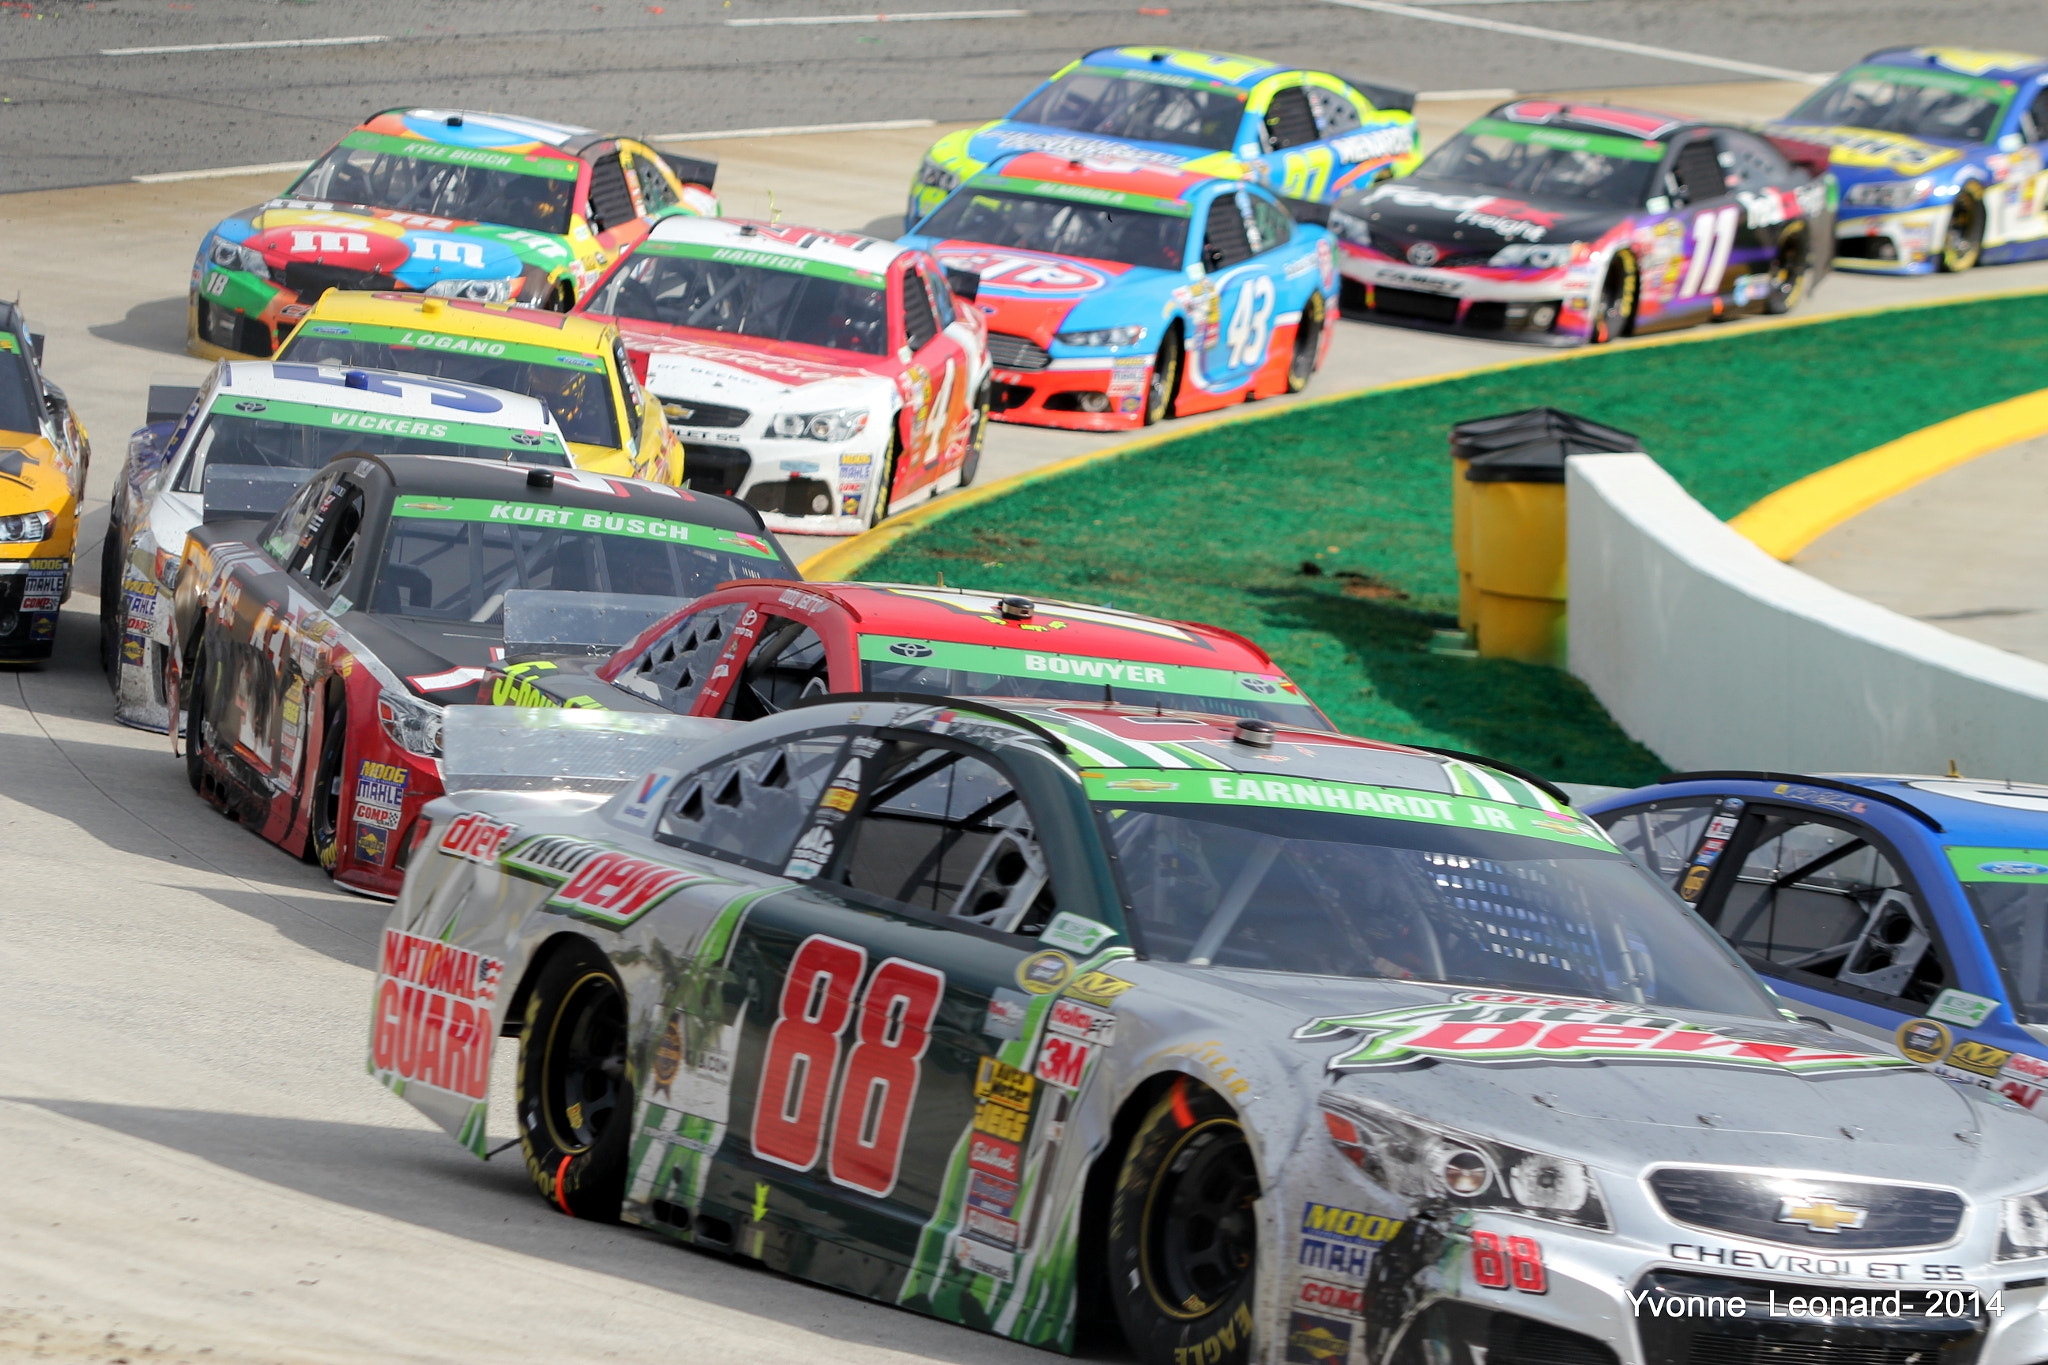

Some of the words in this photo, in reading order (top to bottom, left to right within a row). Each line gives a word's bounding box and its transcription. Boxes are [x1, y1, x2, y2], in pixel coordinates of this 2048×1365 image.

[403, 142, 449, 159] KYLE
[450, 149, 512, 167] BUSCH
[290, 230, 371, 254] m
[1454, 209, 1548, 243] Freight
[412, 236, 486, 269] m
[711, 247, 809, 271] HARVICK
[1679, 206, 1739, 298] 11
[207, 272, 228, 297] 18
[1227, 274, 1276, 370] 43
[400, 331, 506, 356] LOGANO
[331, 411, 448, 438] VICKERS
[490, 504, 570, 526] KURT
[582, 513, 690, 541] BUSCH
[29, 559, 64, 570] MOOG
[24, 577, 63, 592] MAHLE
[23, 597, 49, 609] COMP
[1024, 653, 1167, 685] BOWYER
[360, 760, 409, 785] MOOG
[357, 779, 403, 806] MAHLE
[1210, 776, 1453, 824] EARNHARDT
[1470, 802, 1516, 831] JR
[356, 805, 389, 822] COMP
[441, 815, 512, 862] diet
[383, 929, 479, 1000] NATIONAL
[373, 978, 493, 1100] GUARD
[751, 934, 946, 1199] 88
[1039, 1036, 1088, 1089] 3M
[1299, 1238, 1370, 1278] MAH
[1471, 1229, 1548, 1294] 88
[1669, 1243, 1908, 1281] CHEVROLET
[1921, 1264, 1965, 1281] SS
[1301, 1282, 1365, 1312] COM
